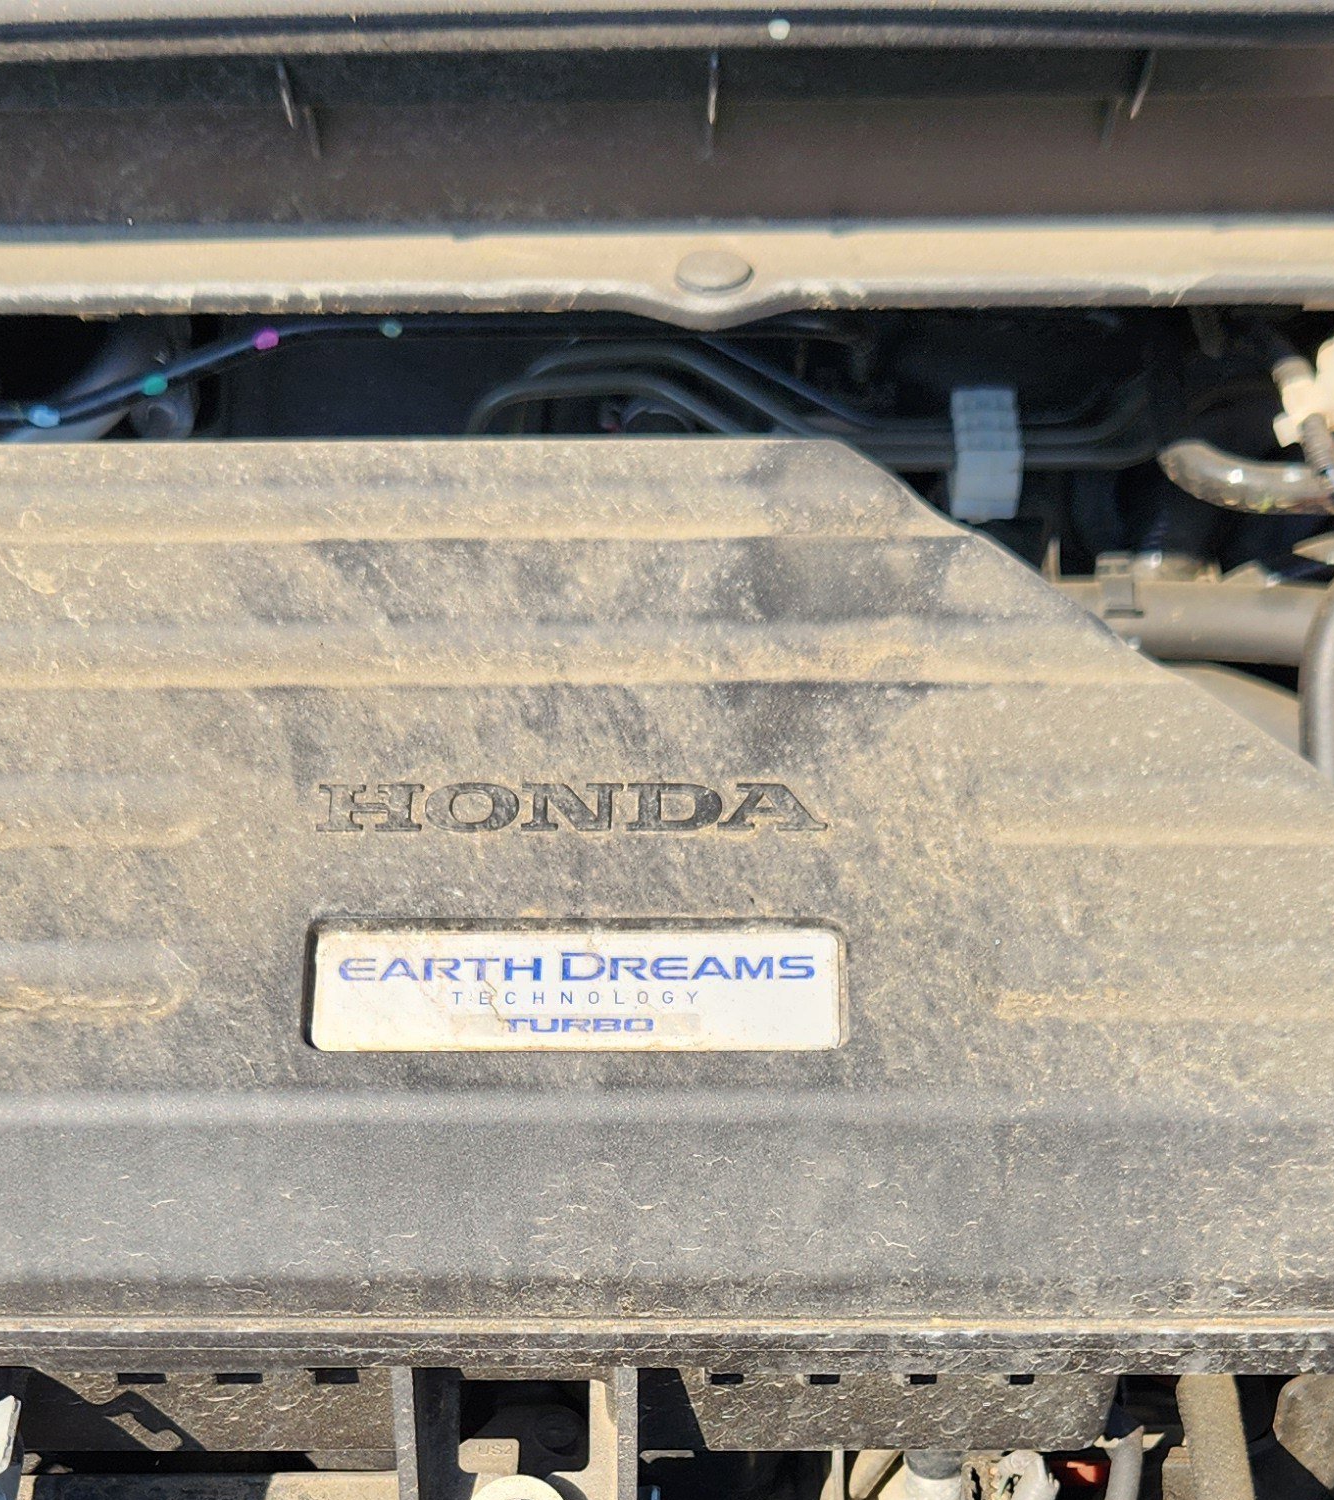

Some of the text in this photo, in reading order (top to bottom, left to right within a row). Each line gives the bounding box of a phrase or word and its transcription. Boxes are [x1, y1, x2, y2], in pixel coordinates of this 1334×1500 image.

[316, 782, 829, 832] HONDA
[338, 951, 816, 982] EARTH DREAMS
[451, 990, 701, 1006] TECHNOLOGY
[505, 1016, 655, 1034] TURBO
